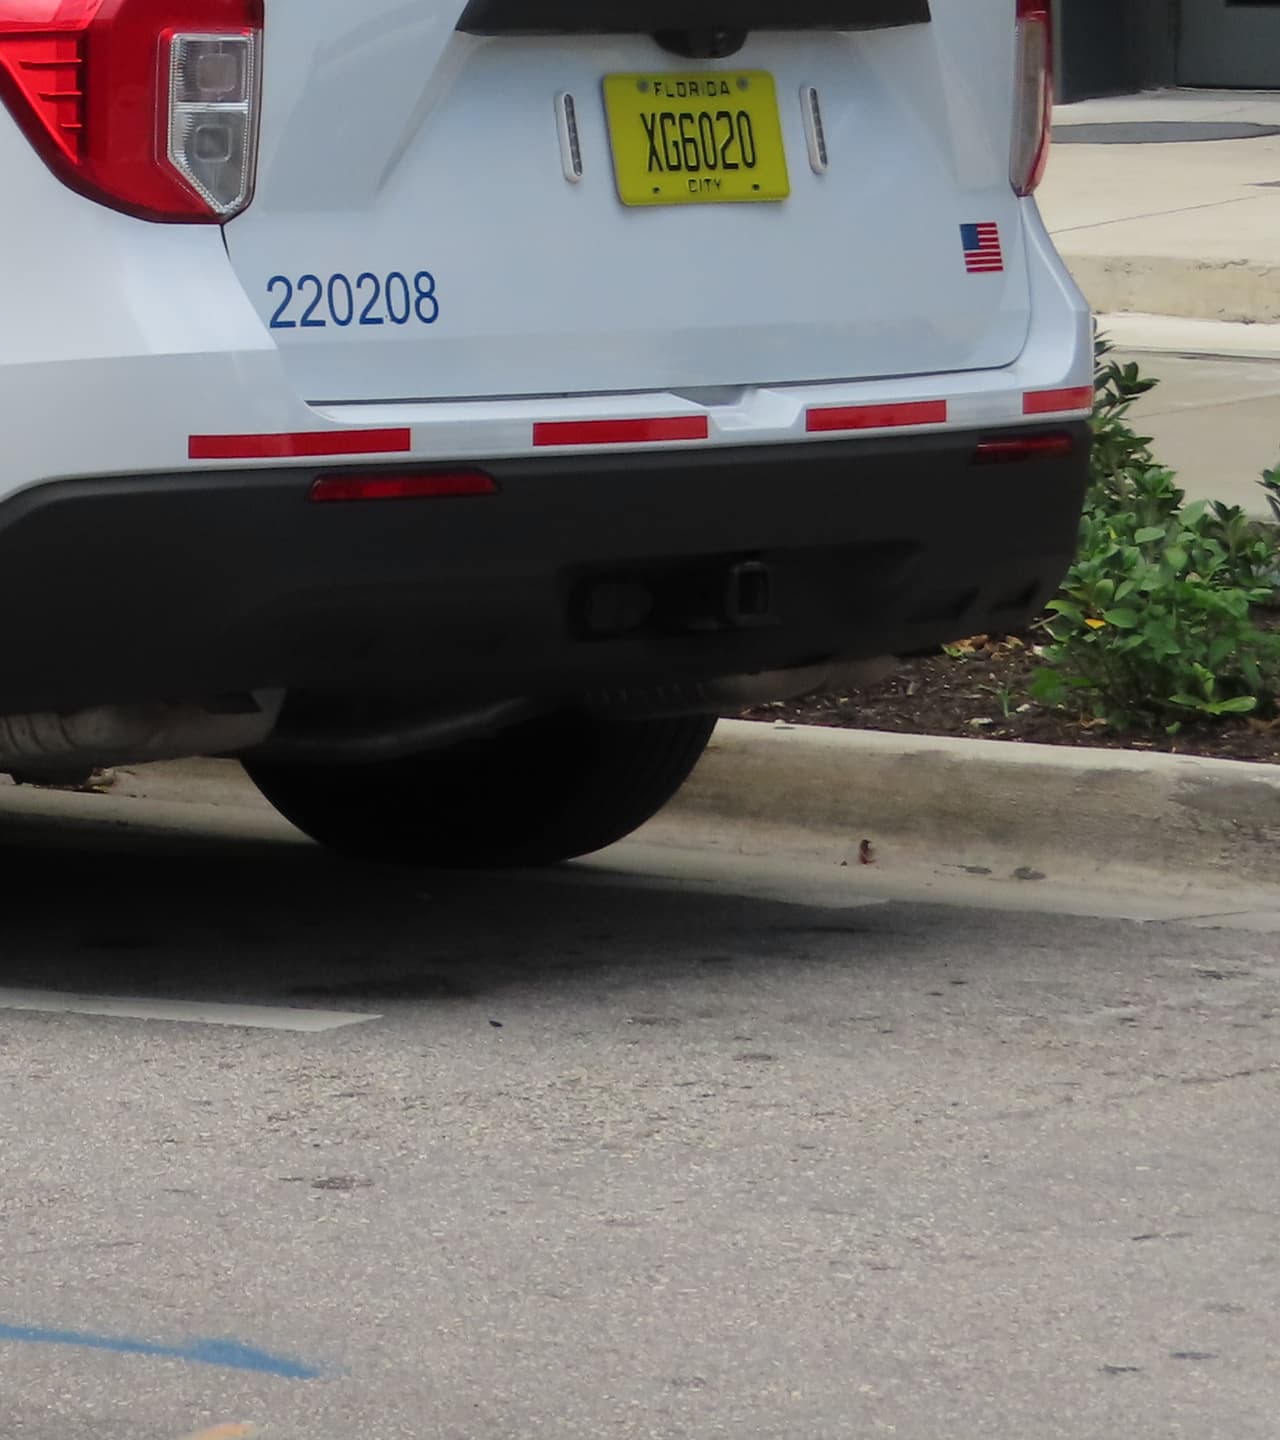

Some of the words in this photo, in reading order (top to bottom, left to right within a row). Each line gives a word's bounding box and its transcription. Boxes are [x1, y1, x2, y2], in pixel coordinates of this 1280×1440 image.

[653, 80, 731, 98] FLORIDA
[640, 110, 757, 172] XG6020
[687, 178, 724, 193] CITY
[266, 270, 440, 329] 220208
